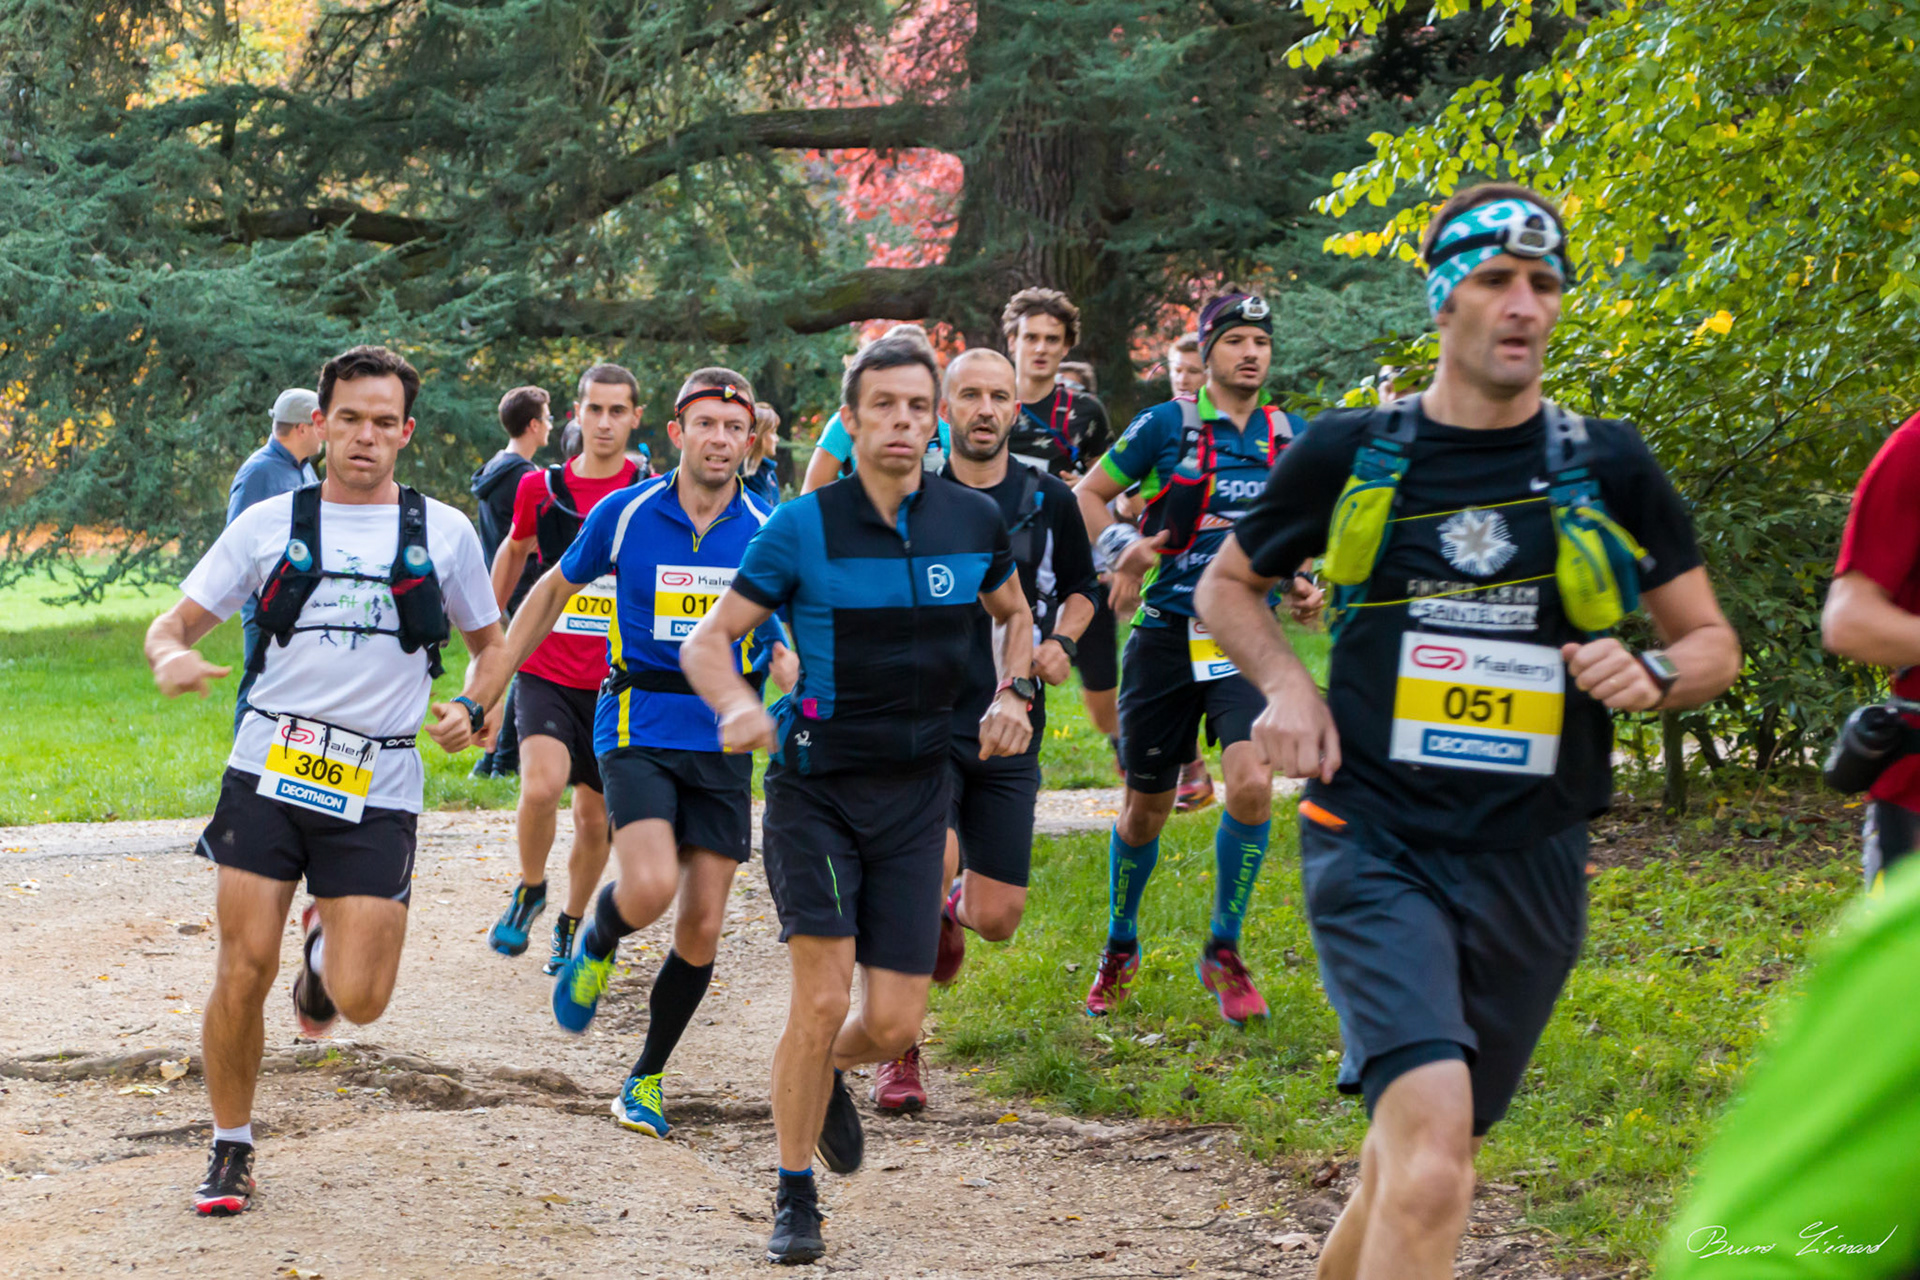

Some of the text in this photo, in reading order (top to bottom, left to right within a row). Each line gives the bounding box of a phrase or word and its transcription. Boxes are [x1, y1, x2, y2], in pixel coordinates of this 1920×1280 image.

[576, 596, 612, 615] 070
[682, 595, 720, 614] 01
[1444, 686, 1515, 725] 051
[295, 754, 344, 785] 306
[281, 782, 344, 810] DECATHLON
